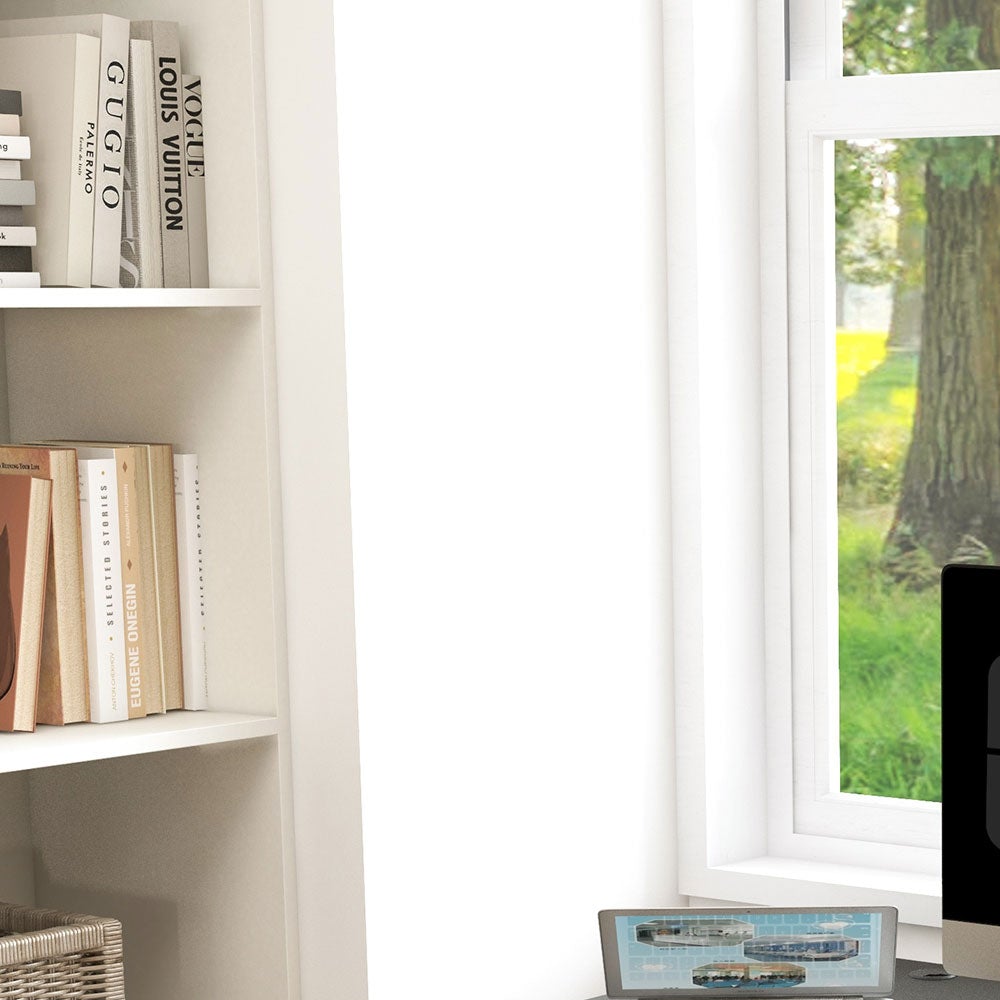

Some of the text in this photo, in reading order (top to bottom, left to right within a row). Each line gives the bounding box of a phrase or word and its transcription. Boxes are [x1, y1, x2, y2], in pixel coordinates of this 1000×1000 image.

[84, 121, 96, 195] PALERMO
[101, 60, 126, 210] GUGIO
[158, 56, 184, 231] LOUIS VUITTON
[183, 79, 206, 178] VOGUE
[100, 485, 114, 627] SELECTED STORIES
[125, 582, 142, 709] EUGENE ONEGIN
